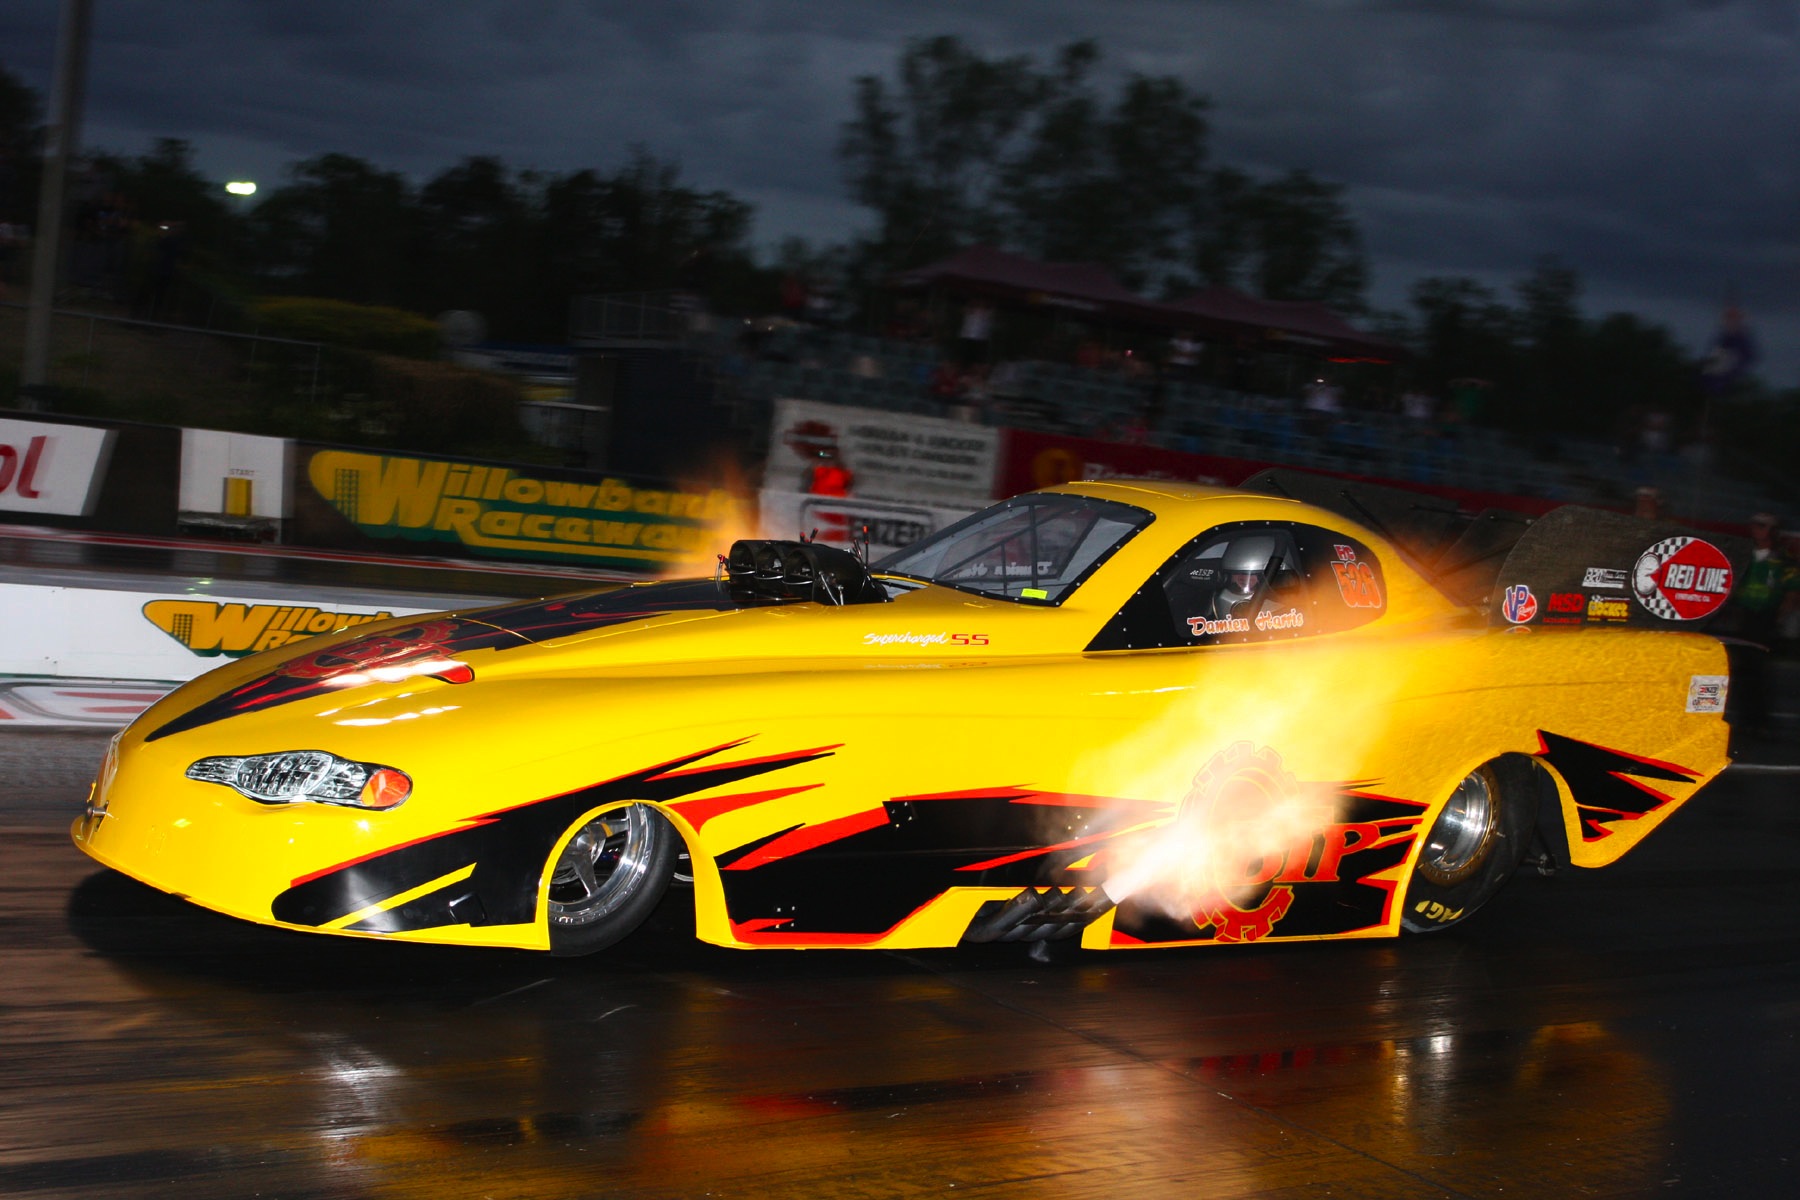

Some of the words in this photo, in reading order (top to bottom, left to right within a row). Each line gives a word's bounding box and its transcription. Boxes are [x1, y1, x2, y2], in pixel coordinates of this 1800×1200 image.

[1664, 563, 1695, 590] RED
[1694, 566, 1729, 594] LINE
[1506, 584, 1529, 622] VP
[1187, 616, 1250, 637] Damien
[1255, 608, 1304, 632] Harris
[863, 632, 949, 647] Supercharged
[950, 633, 989, 646] SS
